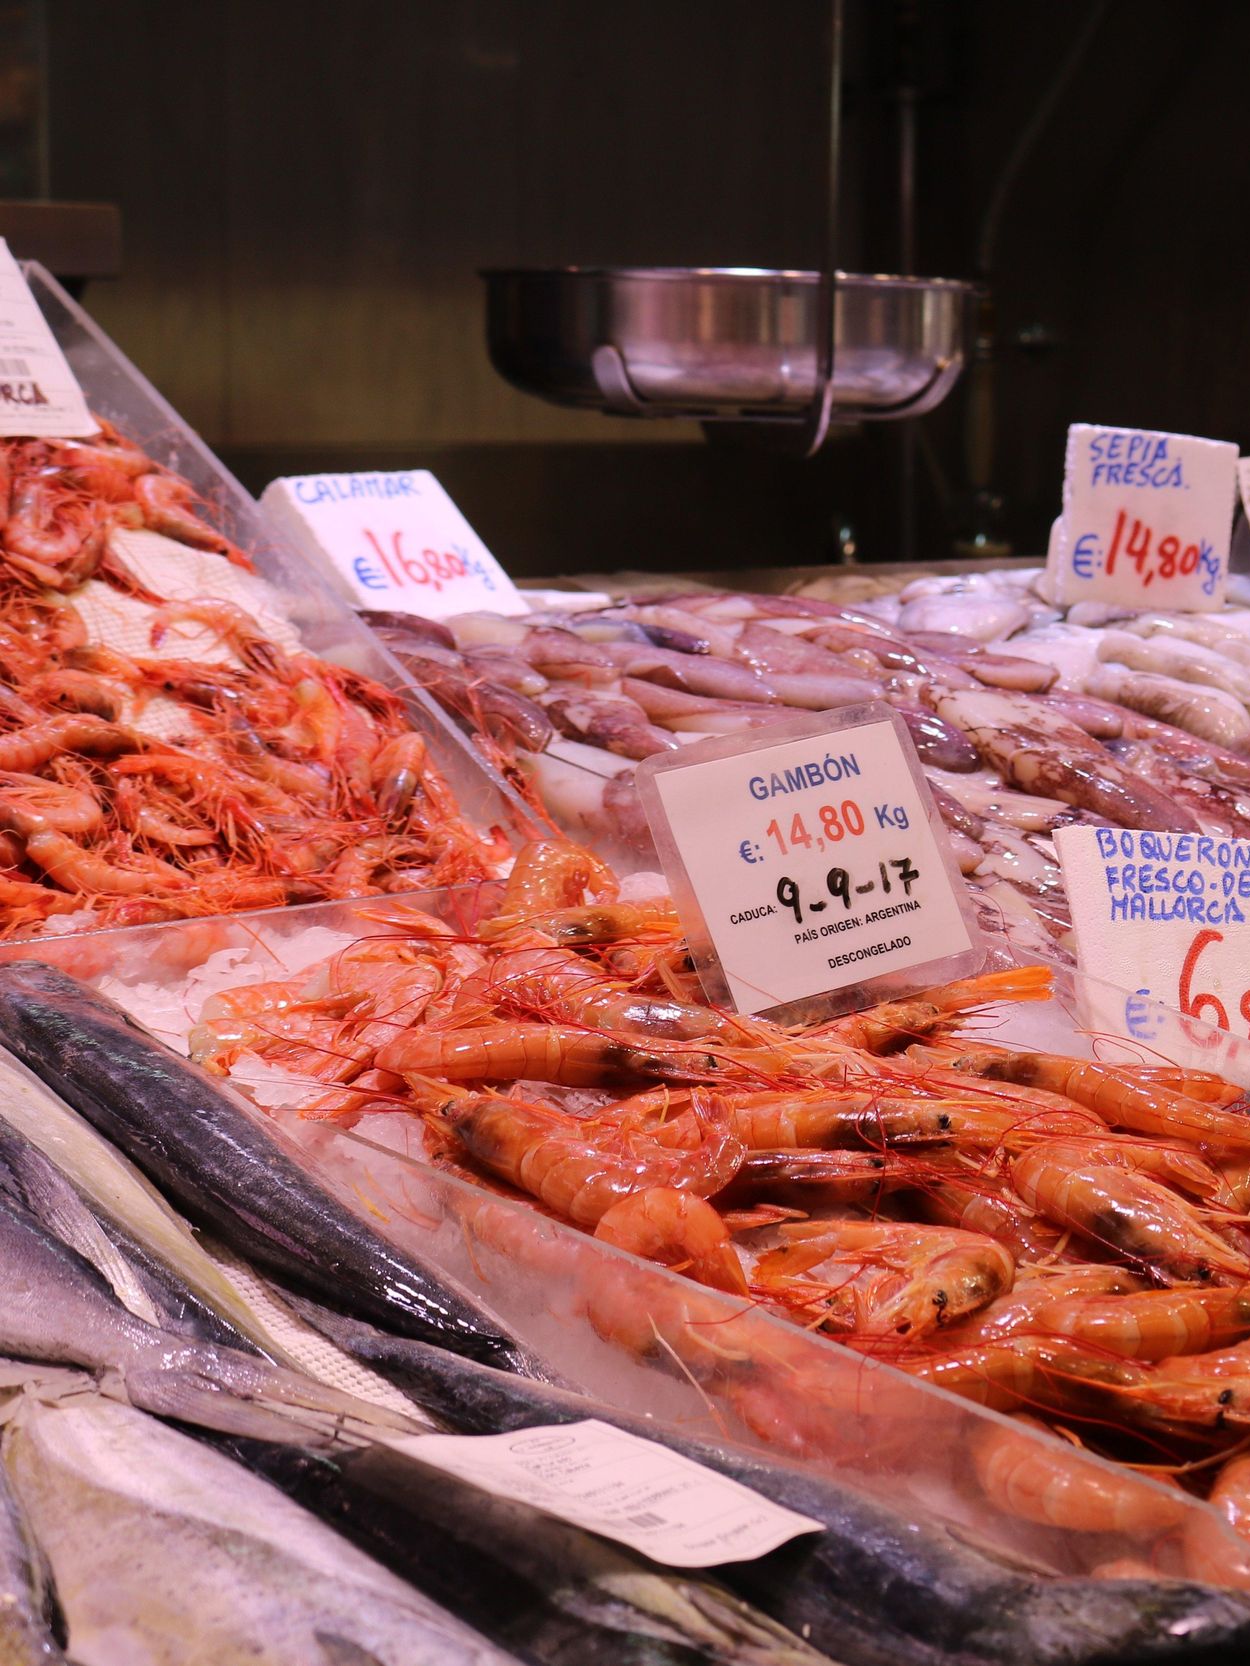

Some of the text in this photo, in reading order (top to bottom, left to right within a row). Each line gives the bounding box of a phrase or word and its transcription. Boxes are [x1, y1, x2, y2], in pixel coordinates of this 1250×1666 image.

[295, 475, 422, 504] CALAMAR
[363, 528, 466, 592] 16,80
[1105, 508, 1200, 588] 14,80
[749, 753, 861, 801] GAMBÓN
[766, 800, 865, 856] 14,80
[874, 804, 910, 830] Kg
[729, 904, 779, 926] CADUCA:
[794, 900, 922, 945] PAÍS ORIGEN: ARGENTINA
[827, 935, 912, 969] DESCONGELADO
